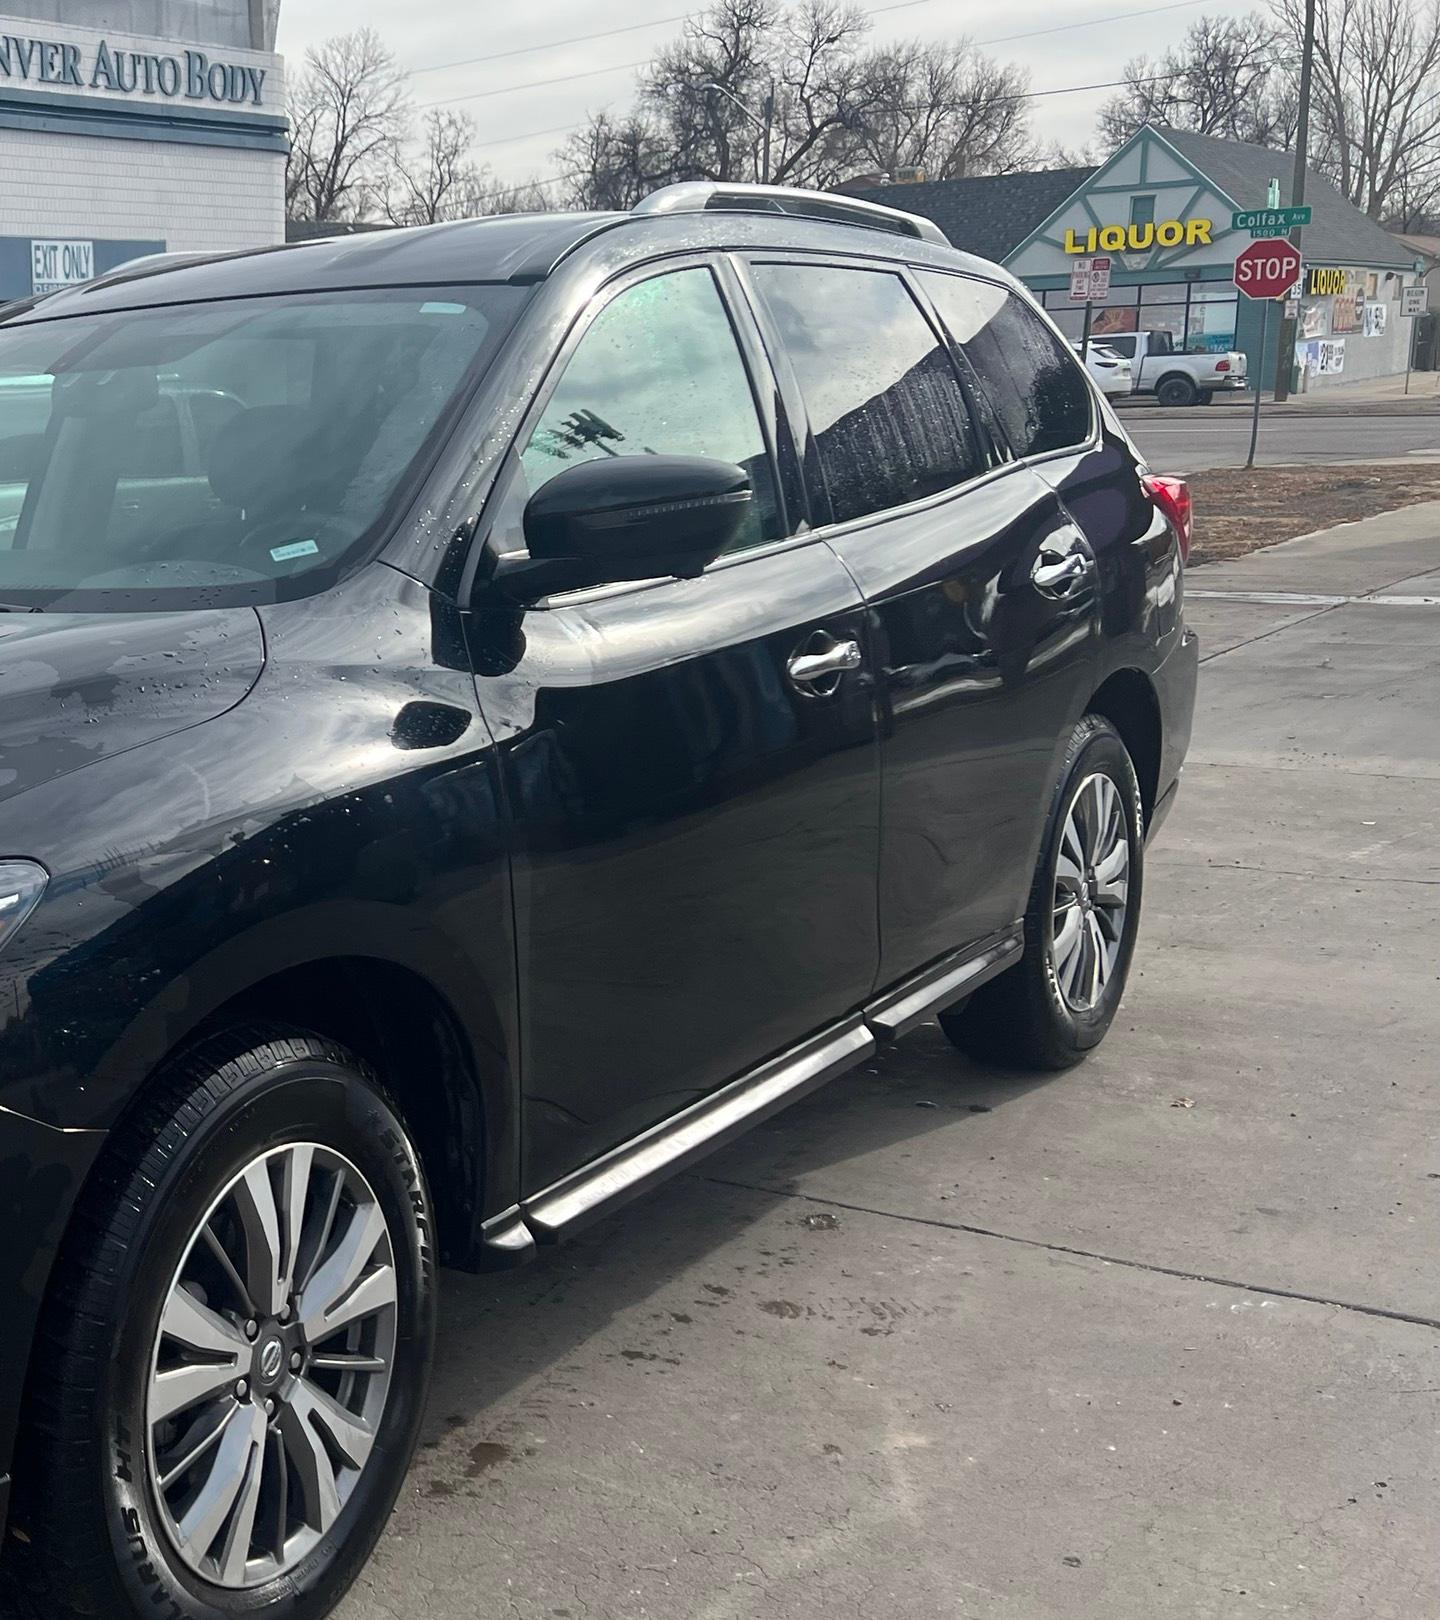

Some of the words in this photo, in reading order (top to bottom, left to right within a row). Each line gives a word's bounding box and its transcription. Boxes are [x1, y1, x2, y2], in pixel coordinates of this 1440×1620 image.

[90, 40, 182, 97] AUTO
[185, 50, 267, 106] BODY
[1236, 213, 1286, 227] Colfax
[1064, 219, 1213, 254] LIQUOR
[33, 245, 58, 279] EXIT
[62, 245, 91, 279] ONLY
[1238, 257, 1296, 282] STOP
[1310, 269, 1346, 296] LIQUOR
